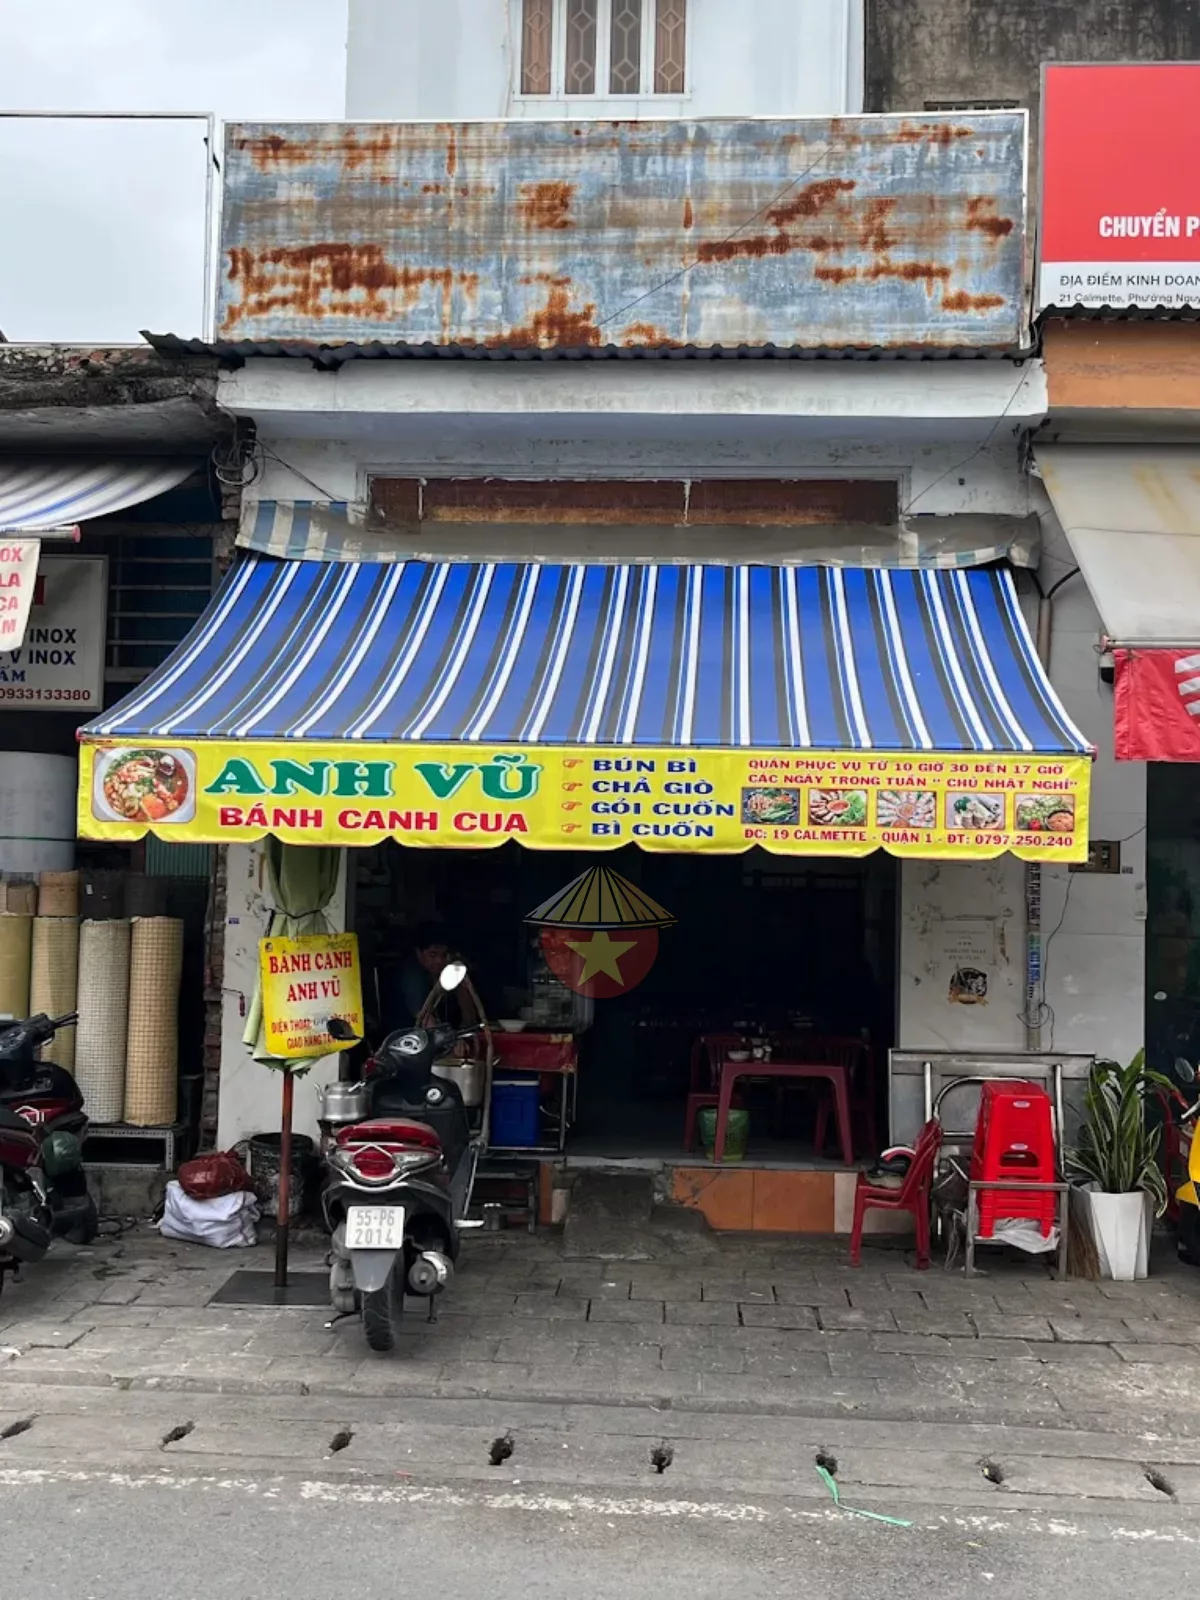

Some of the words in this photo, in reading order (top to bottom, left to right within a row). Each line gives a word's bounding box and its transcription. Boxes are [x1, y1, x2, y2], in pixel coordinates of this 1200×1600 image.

[1099, 207, 1180, 237] CHUYỂN
[1060, 275, 1083, 288] ĐỊA
[1126, 275, 1160, 286] KINH
[1060, 294, 1071, 302] 21
[29, 628, 77, 644] INOX
[28, 650, 76, 665] INOX
[593, 756, 655, 773] BÚN
[667, 757, 697, 773] BÌ
[749, 758, 790, 770] QUÁN
[795, 760, 836, 771] PHỤC
[841, 761, 861, 772] VỤ
[895, 763, 913, 771] 10
[918, 761, 944, 773] GIỜ
[950, 763, 969, 772] 30
[975, 761, 1007, 773] ĐẾN
[1014, 765, 1031, 774] 17
[1037, 763, 1064, 775] GIỜ
[204, 757, 397, 797] ANH
[414, 753, 544, 800] VŨ
[748, 772, 778, 783] CÁC
[784, 773, 823, 784] NGÀY
[829, 776, 880, 785] TRONG
[947, 775, 978, 788] CHỦ
[592, 776, 651, 793] CHẢ
[664, 780, 713, 795] GIÒ
[653, 800, 734, 816] CUỐN
[220, 802, 323, 828] BÁNH
[338, 809, 438, 831] CANH
[454, 811, 528, 832] CUA
[592, 820, 621, 835] BÌ
[633, 820, 714, 837] CUỐN
[744, 829, 767, 839] ĐC:
[773, 830, 789, 840] 19
[794, 830, 867, 842] CALMETTE
[882, 830, 920, 844] QUẬN
[926, 834, 932, 843] 1
[947, 833, 970, 844] ĐT:
[975, 834, 1073, 847] 0797.250.240
[269, 950, 312, 974] BÁNH
[315, 951, 352, 971] CANH
[287, 981, 318, 1002] ANH
[321, 975, 341, 998] VŨ
[357, 1210, 395, 1226] 55-P6
[355, 1228, 393, 1245] 2014
